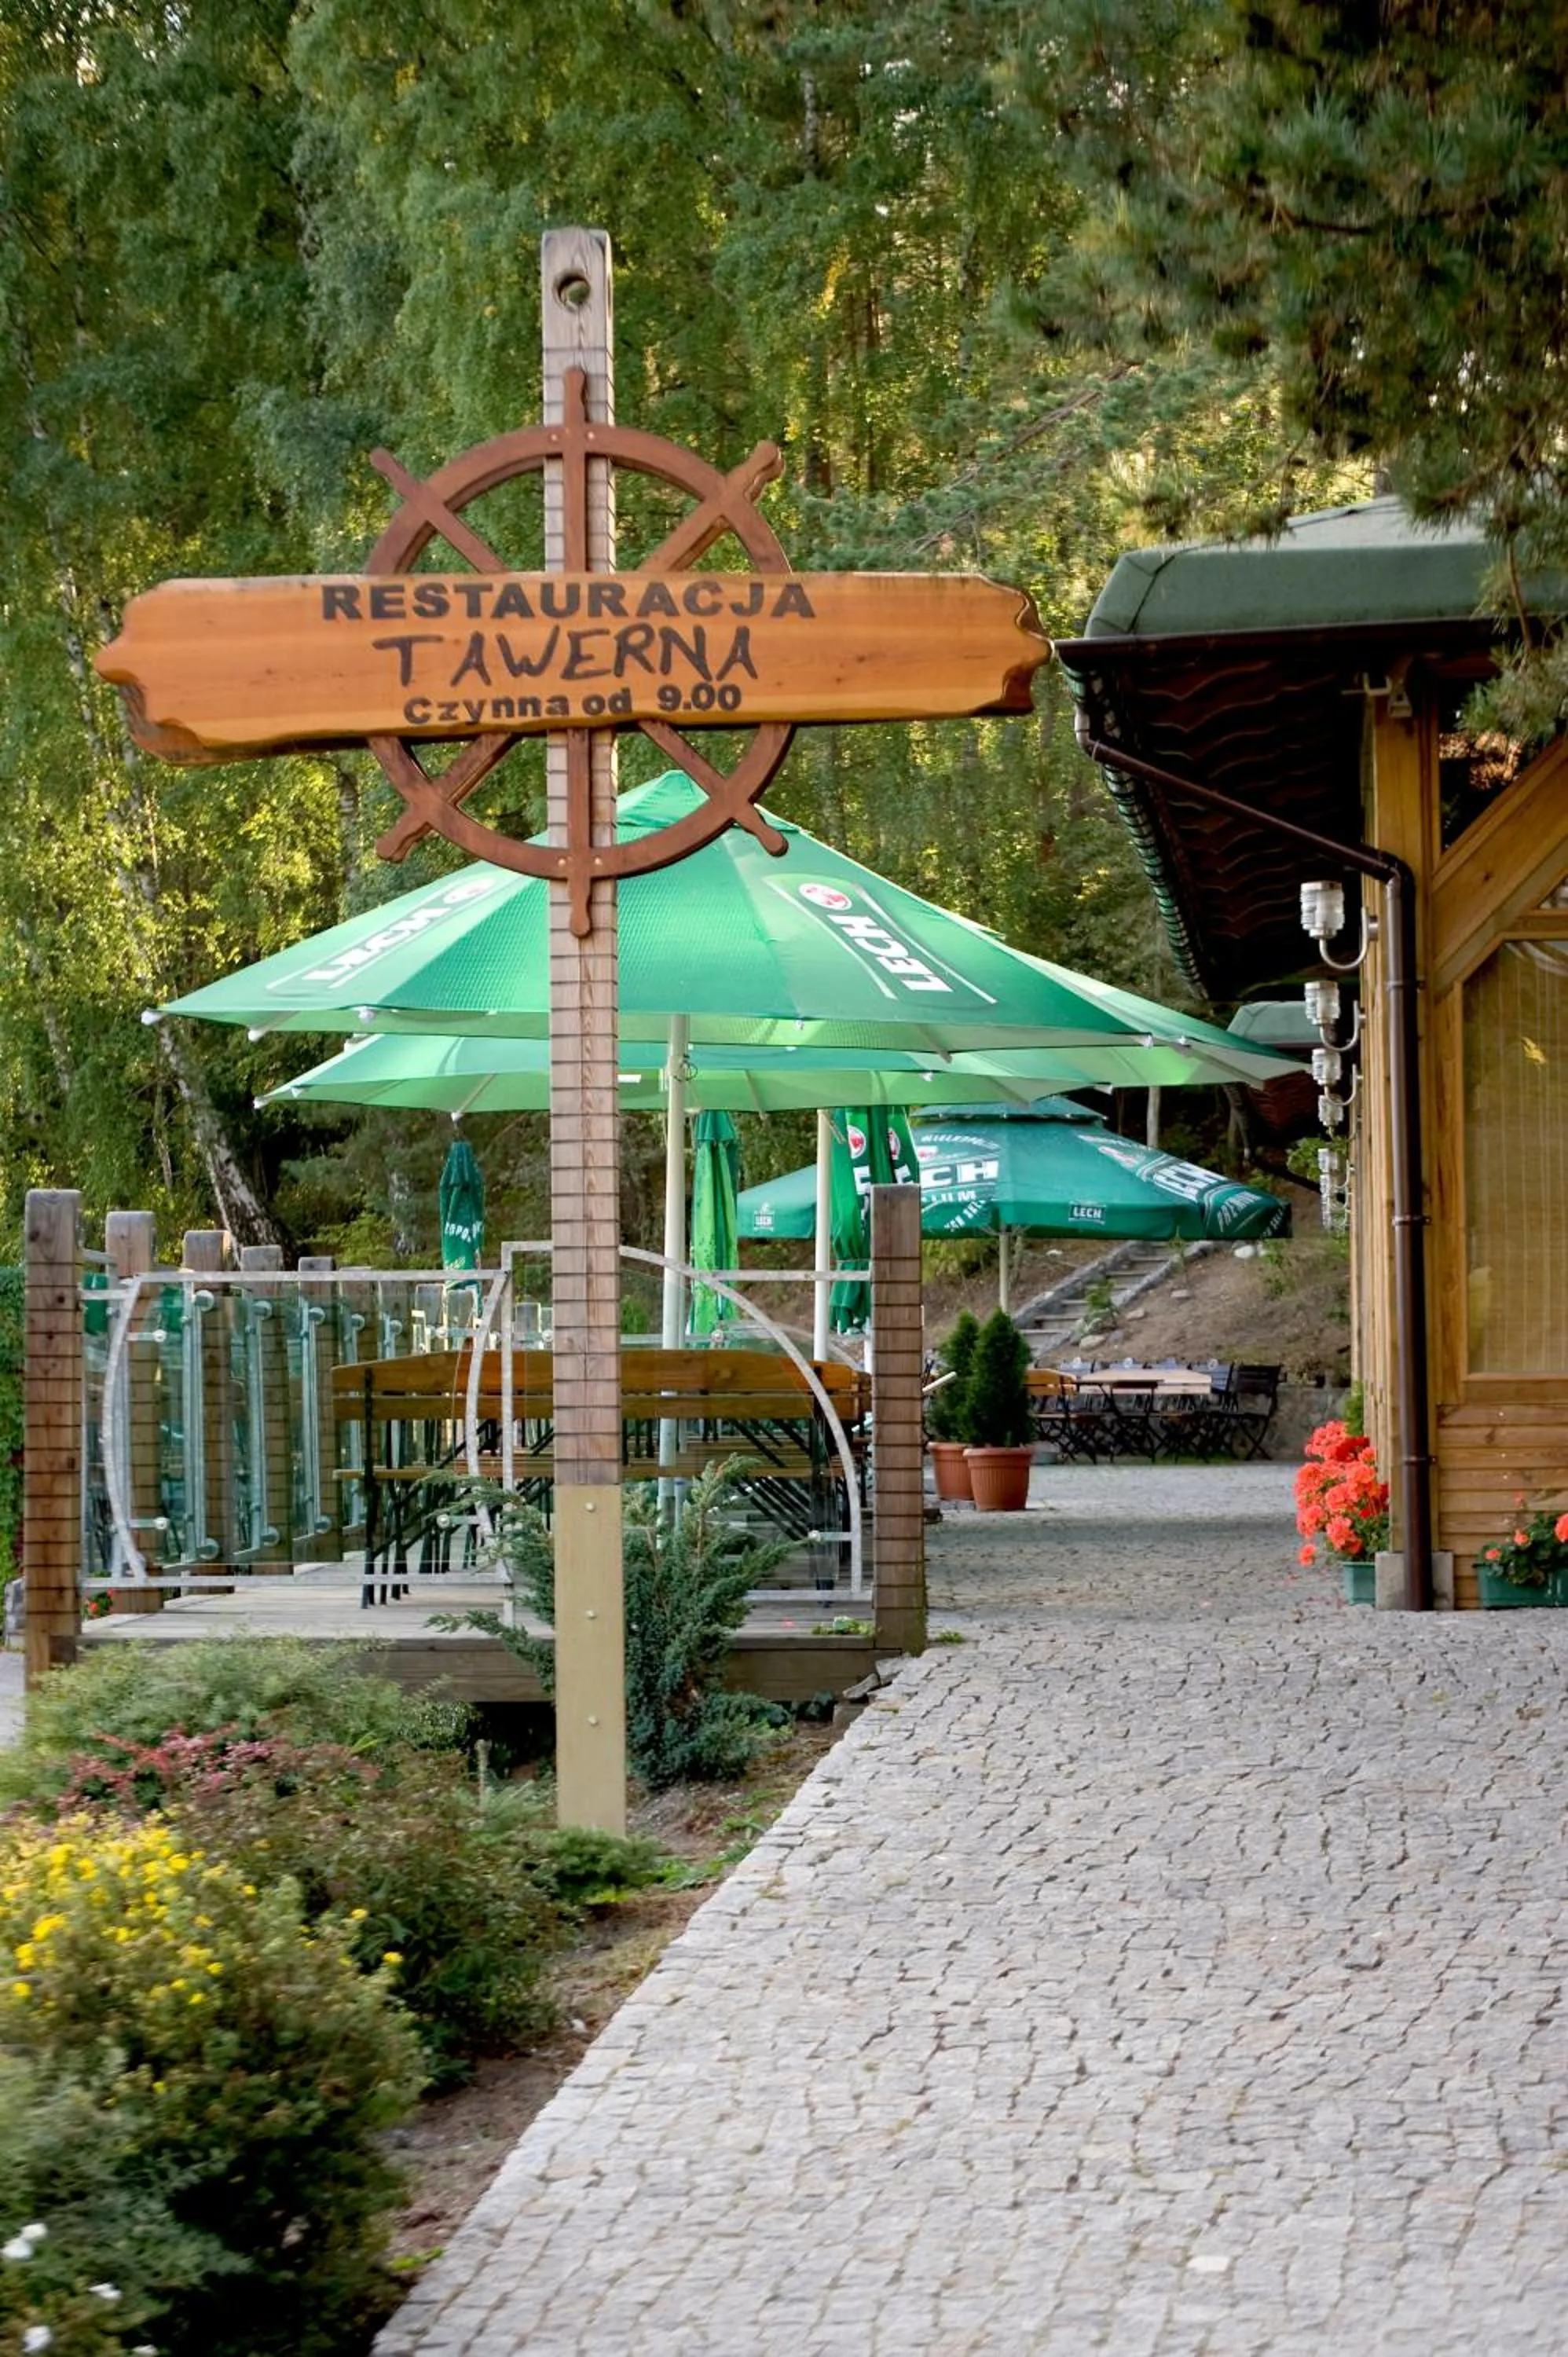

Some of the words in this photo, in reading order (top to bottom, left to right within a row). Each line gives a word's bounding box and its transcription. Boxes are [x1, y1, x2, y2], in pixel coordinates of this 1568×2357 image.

[321, 581, 815, 620] RESTAURACJA
[372, 623, 758, 687] TAWERNA
[403, 694, 570, 725] Czynna
[581, 688, 632, 715] od
[657, 682, 742, 711] 9.00
[302, 907, 452, 981] LECH
[827, 914, 954, 992] LECH
[920, 1160, 999, 1189] CH
[1073, 1206, 1101, 1219] LECH
